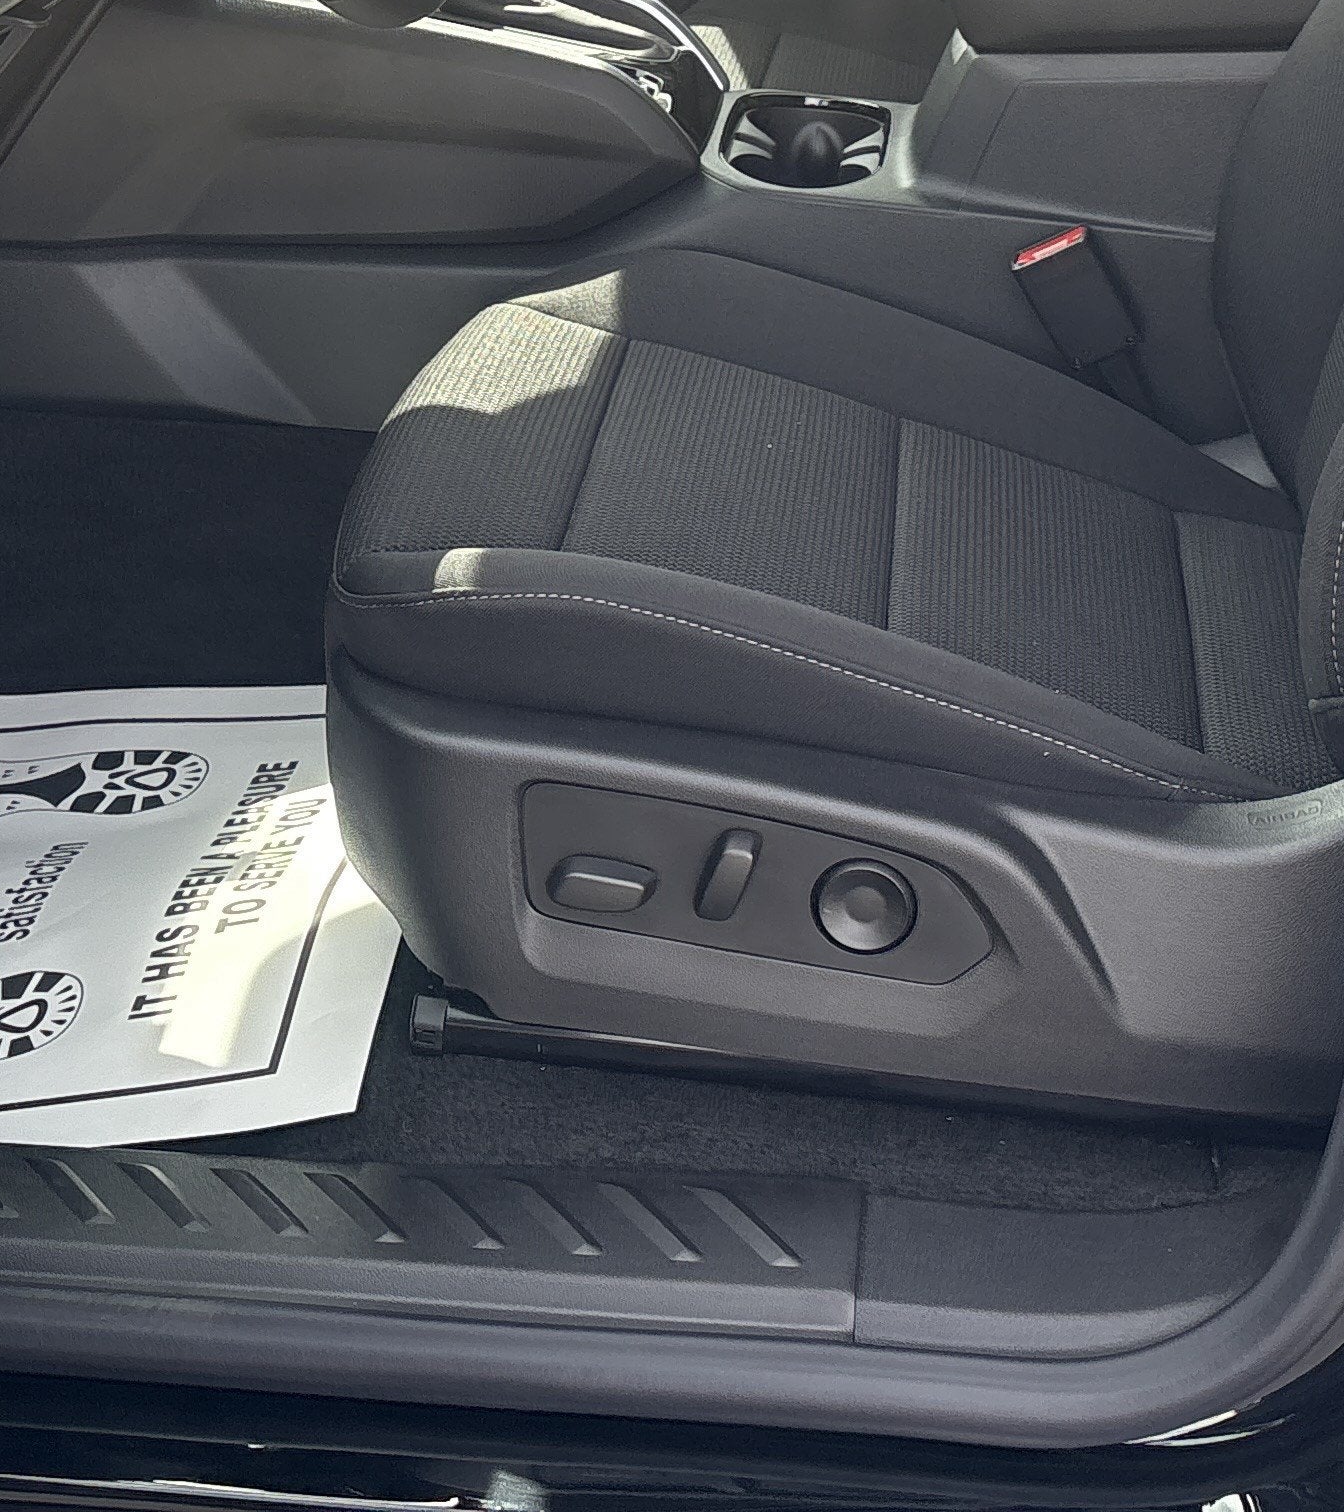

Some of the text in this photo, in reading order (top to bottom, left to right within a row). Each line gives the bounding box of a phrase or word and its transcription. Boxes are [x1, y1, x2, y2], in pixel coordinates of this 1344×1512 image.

[127, 760, 299, 1021] IT HAS BEEN A PLEASURE
[214, 798, 327, 934] TO SERVE YOU
